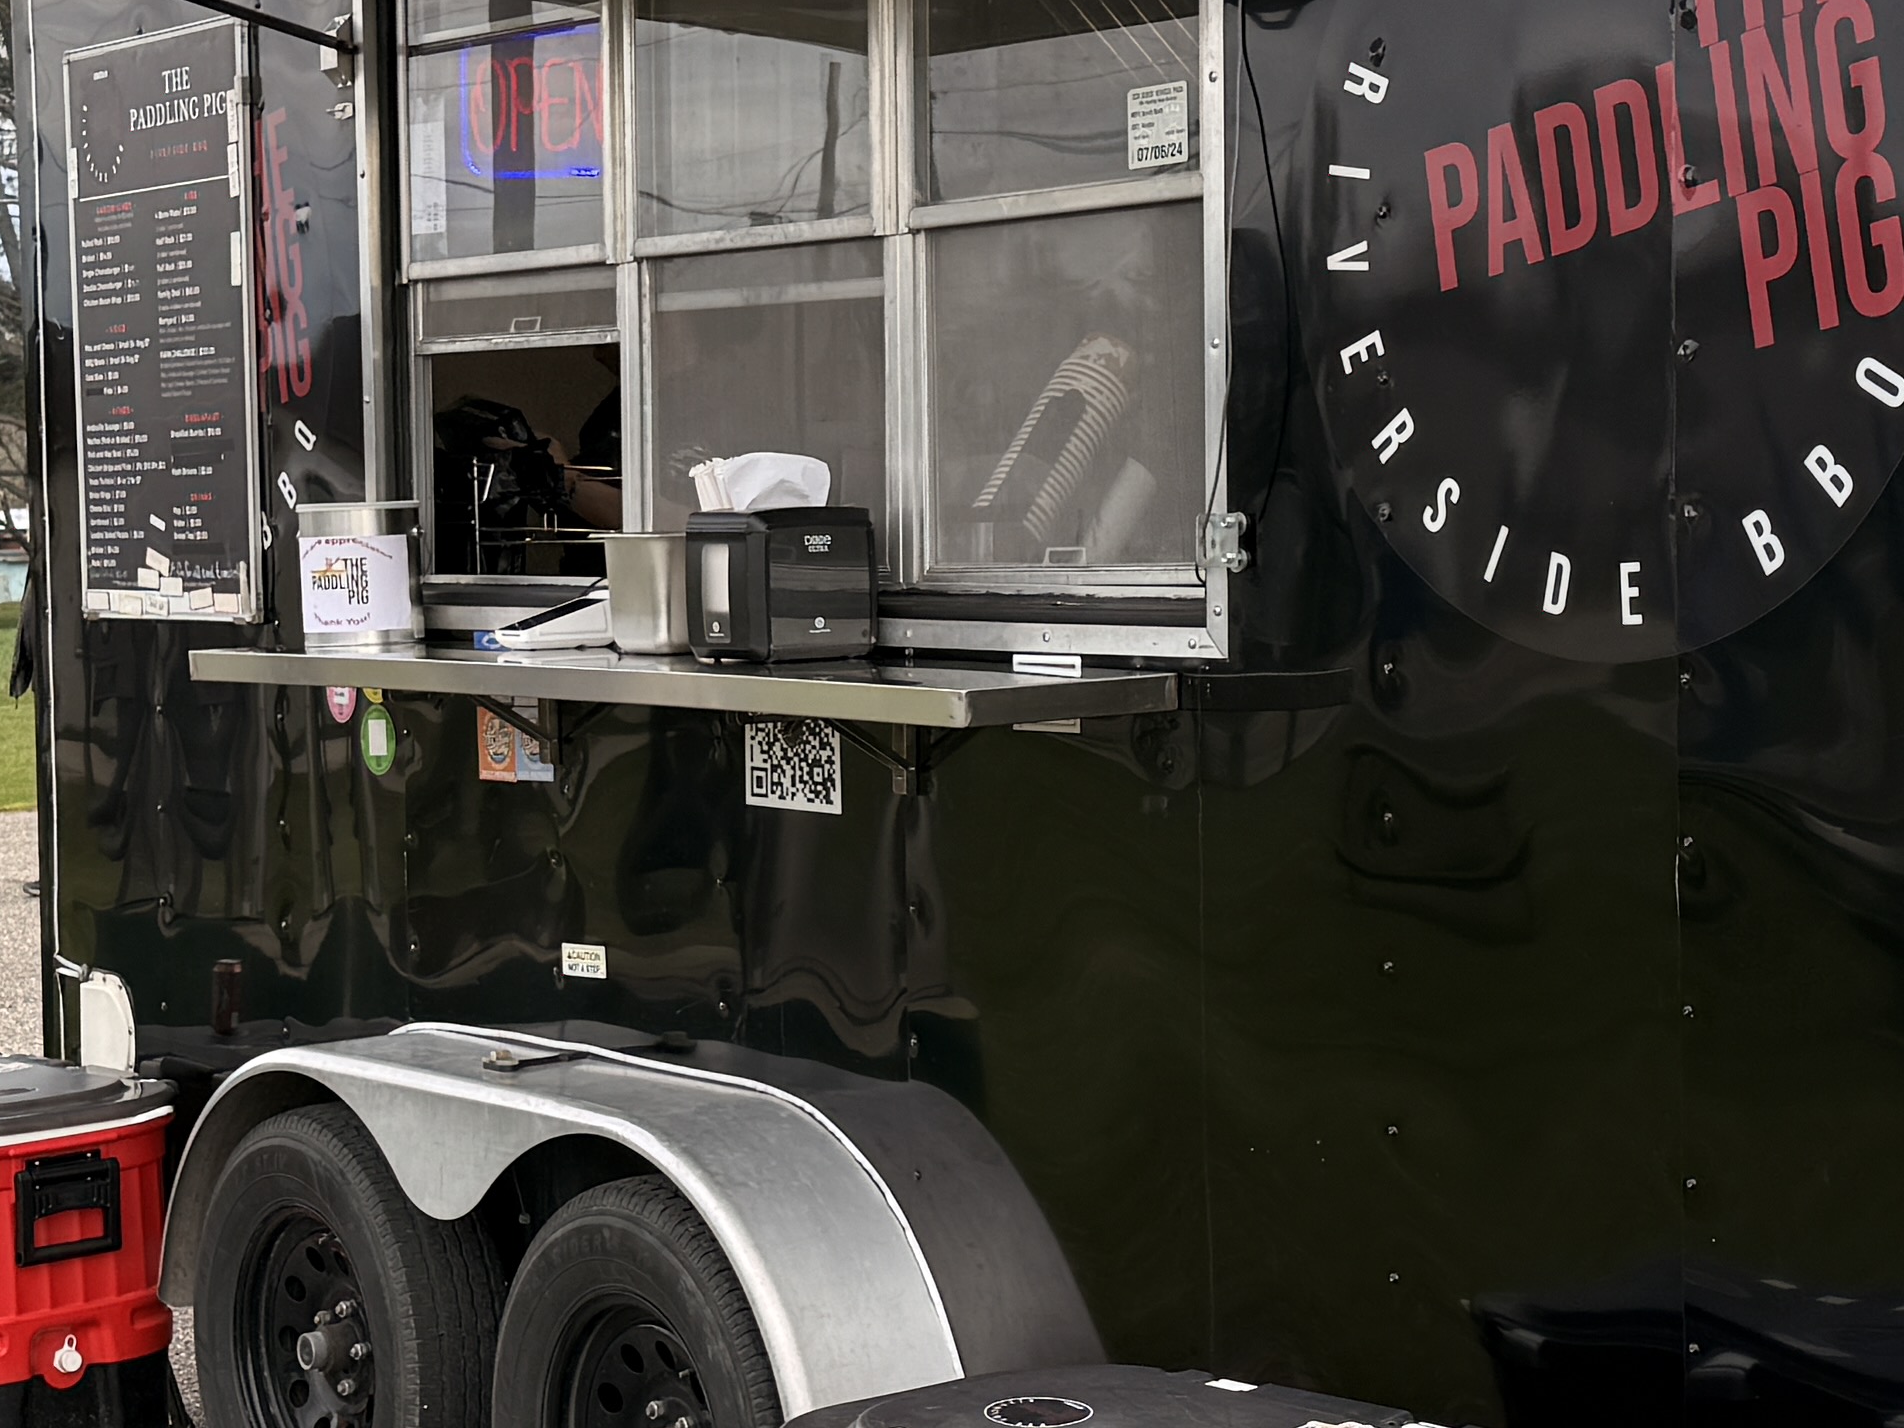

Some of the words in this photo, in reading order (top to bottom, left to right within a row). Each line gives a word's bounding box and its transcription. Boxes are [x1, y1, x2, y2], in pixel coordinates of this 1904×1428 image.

[162, 66, 191, 94] THE
[129, 96, 199, 132] PADDLING
[203, 90, 226, 118] PIG
[470, 56, 604, 154] OPEN
[1326, 60, 1644, 627] RIVERSIDE
[342, 557, 368, 573] THE
[312, 573, 369, 591] PADDLING
[348, 589, 369, 605] PIG
